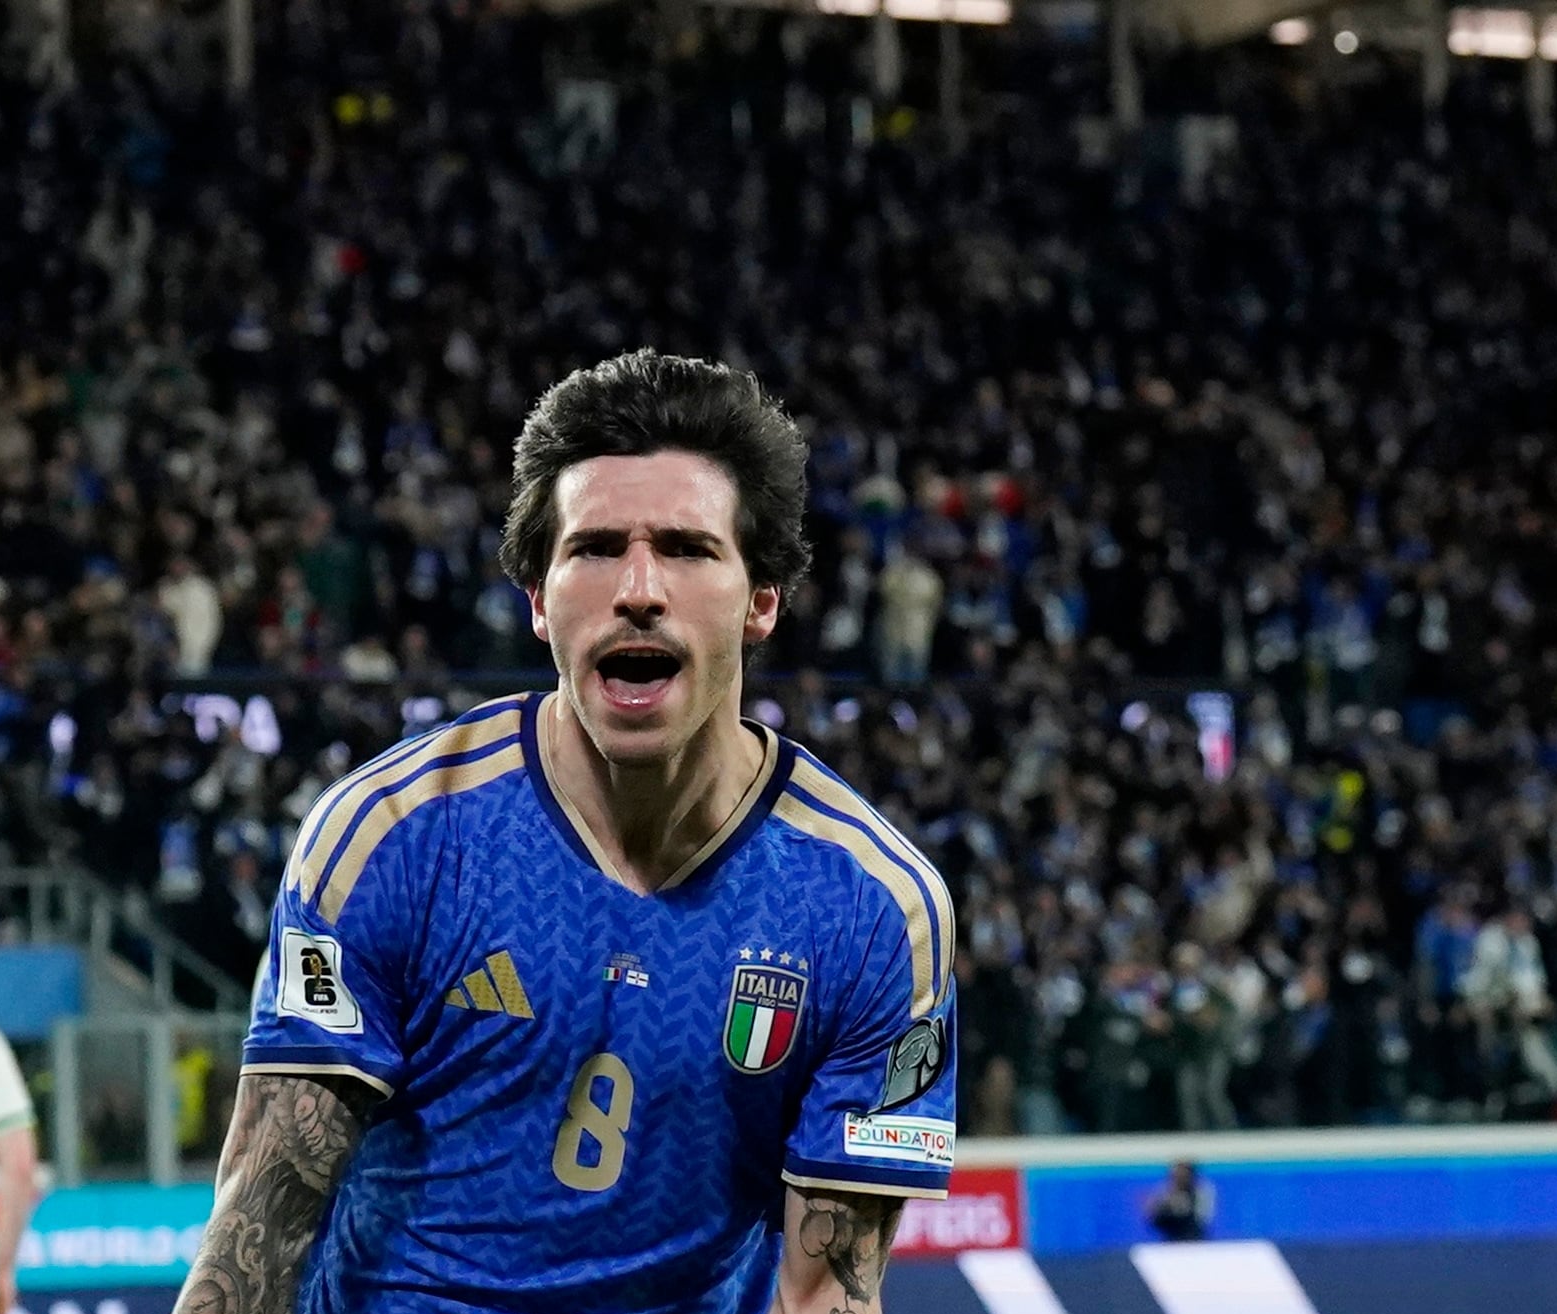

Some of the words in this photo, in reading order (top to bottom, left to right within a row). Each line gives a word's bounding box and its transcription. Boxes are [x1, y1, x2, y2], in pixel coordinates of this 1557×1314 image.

[738, 972, 798, 1002] ITALIA
[552, 1052, 634, 1191] 8
[848, 1125, 954, 1152] FOUNDATION
